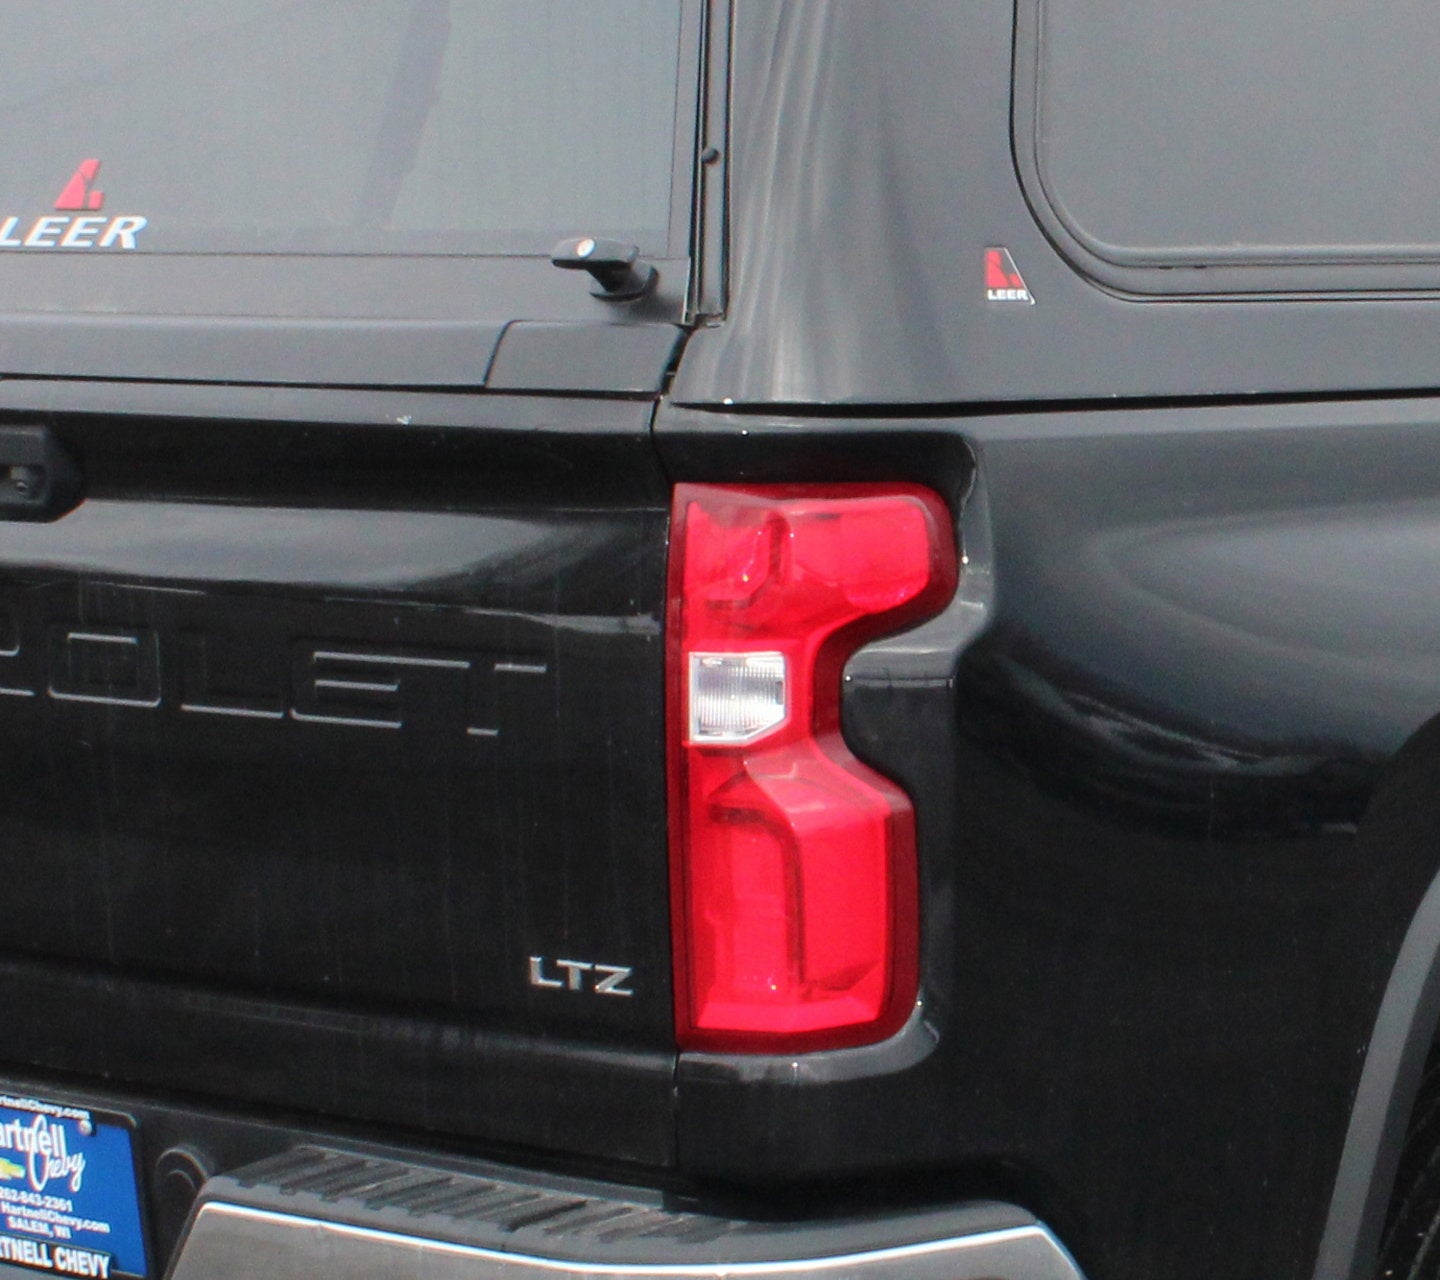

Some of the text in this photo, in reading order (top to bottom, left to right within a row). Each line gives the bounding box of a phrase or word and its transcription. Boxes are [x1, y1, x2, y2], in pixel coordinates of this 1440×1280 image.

[987, 288, 1029, 301] LEER
[529, 955, 634, 996] LTZ
[54, 1247, 111, 1280] CHEVY
